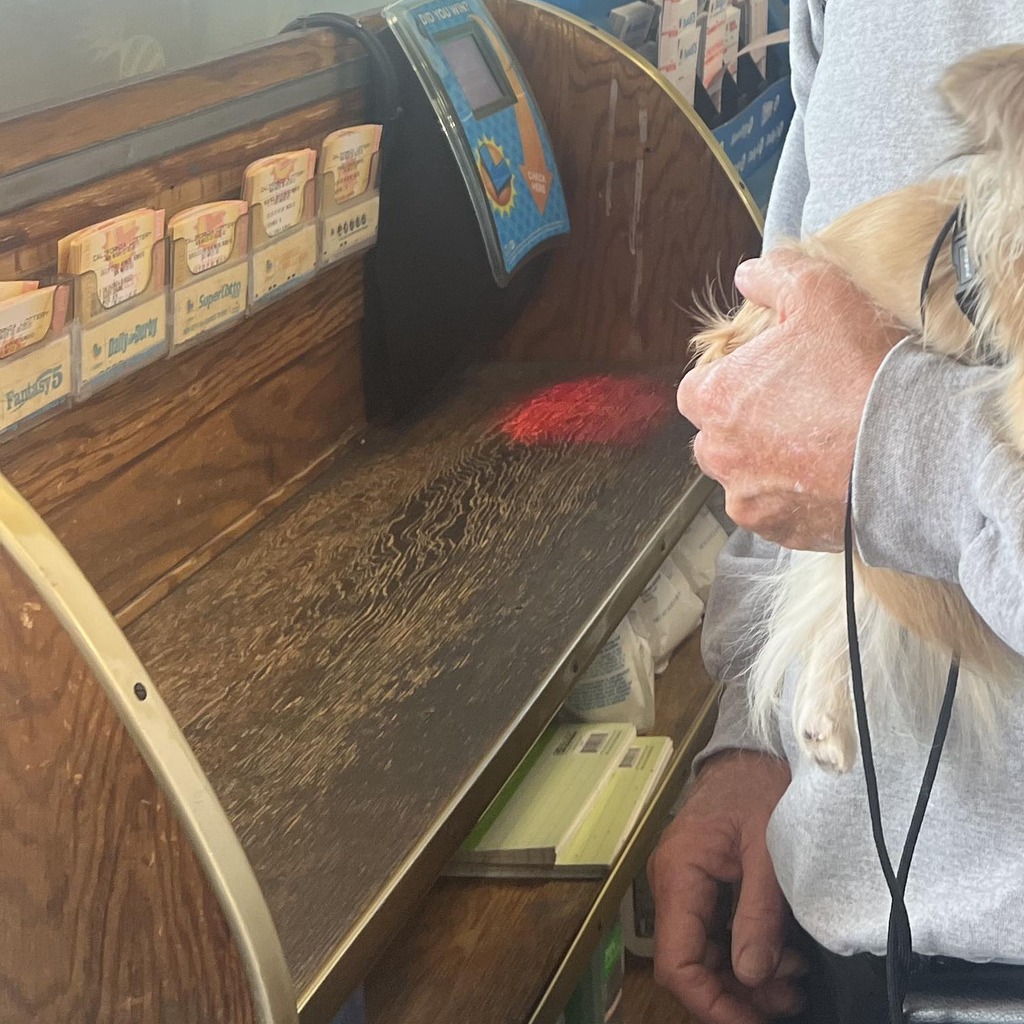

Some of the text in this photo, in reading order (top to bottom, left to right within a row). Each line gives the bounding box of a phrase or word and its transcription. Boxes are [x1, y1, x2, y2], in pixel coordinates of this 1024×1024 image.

[418, 0, 470, 26] DID YOU WIN?
[5, 363, 63, 411] Fantasy 5
